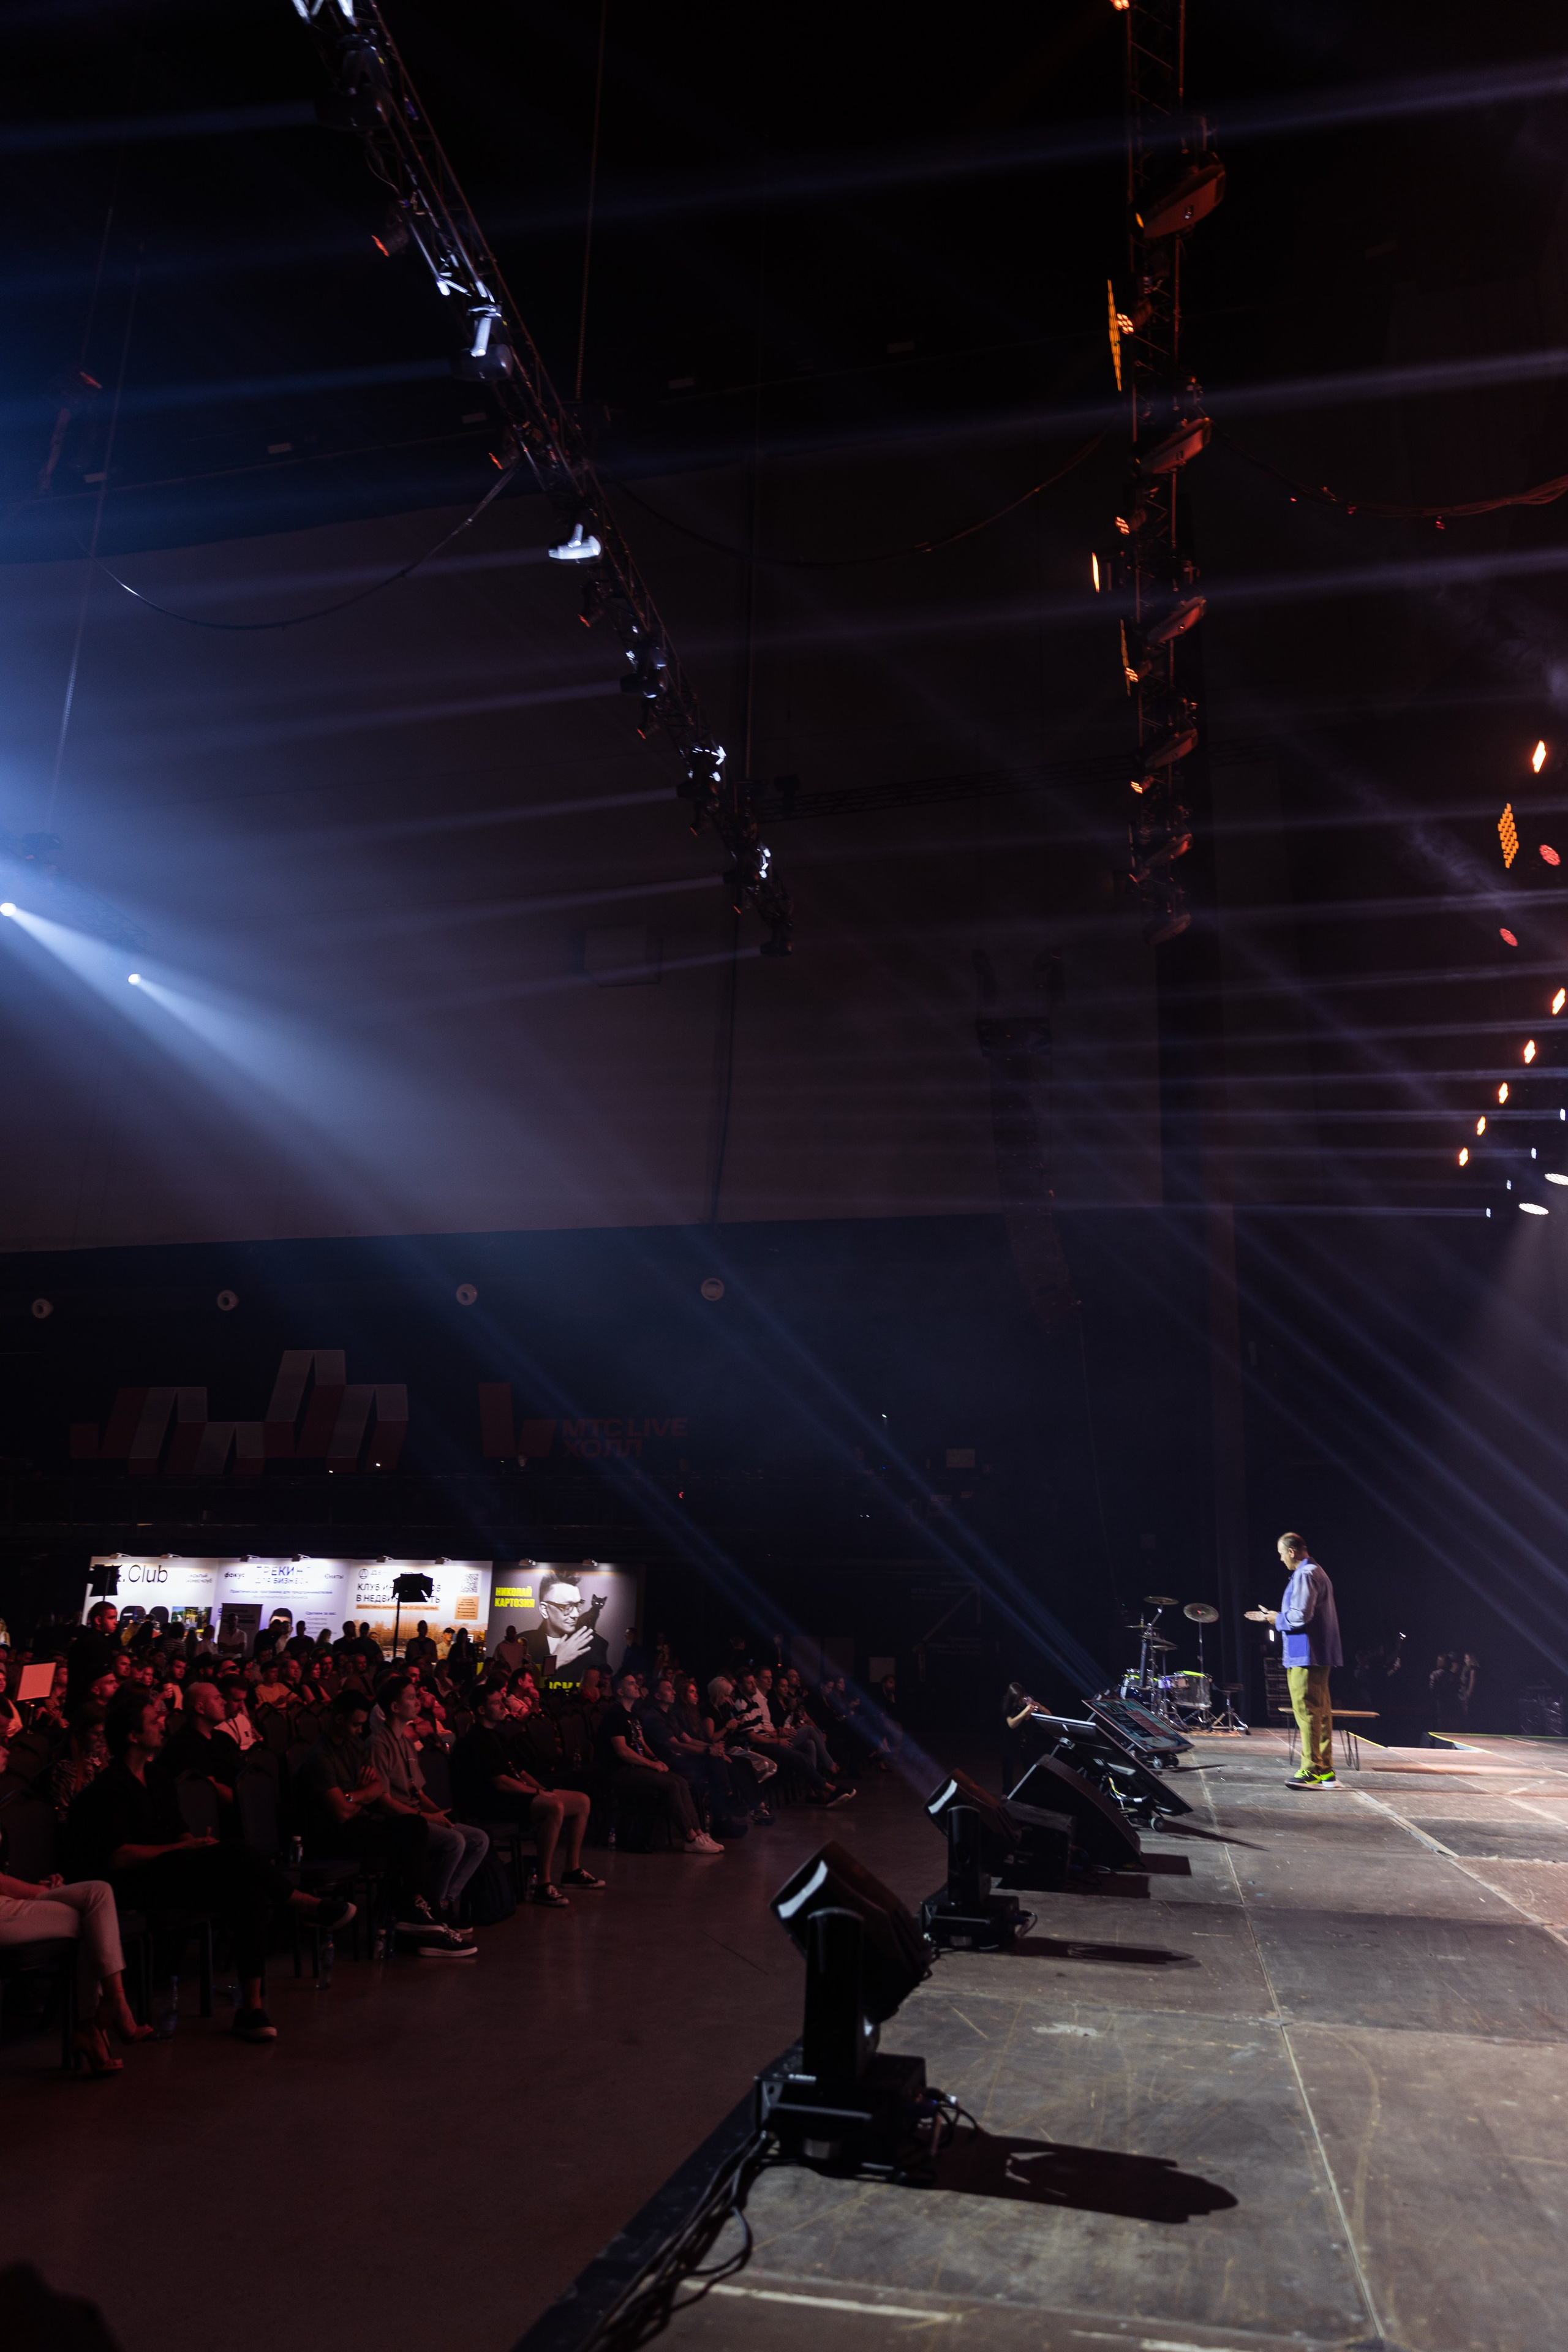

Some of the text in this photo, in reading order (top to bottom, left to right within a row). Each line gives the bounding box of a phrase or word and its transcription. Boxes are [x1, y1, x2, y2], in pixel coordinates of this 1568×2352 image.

[627, 1417, 689, 1437] LIVE
[562, 1439, 643, 1458] ХОЛЛ
[357, 1583, 380, 1591] КЛУБ
[496, 1586, 533, 1597] НИКОЛАЙ
[356, 1594, 362, 1602] В
[494, 1597, 535, 1608] КАРТОЗИЯ
